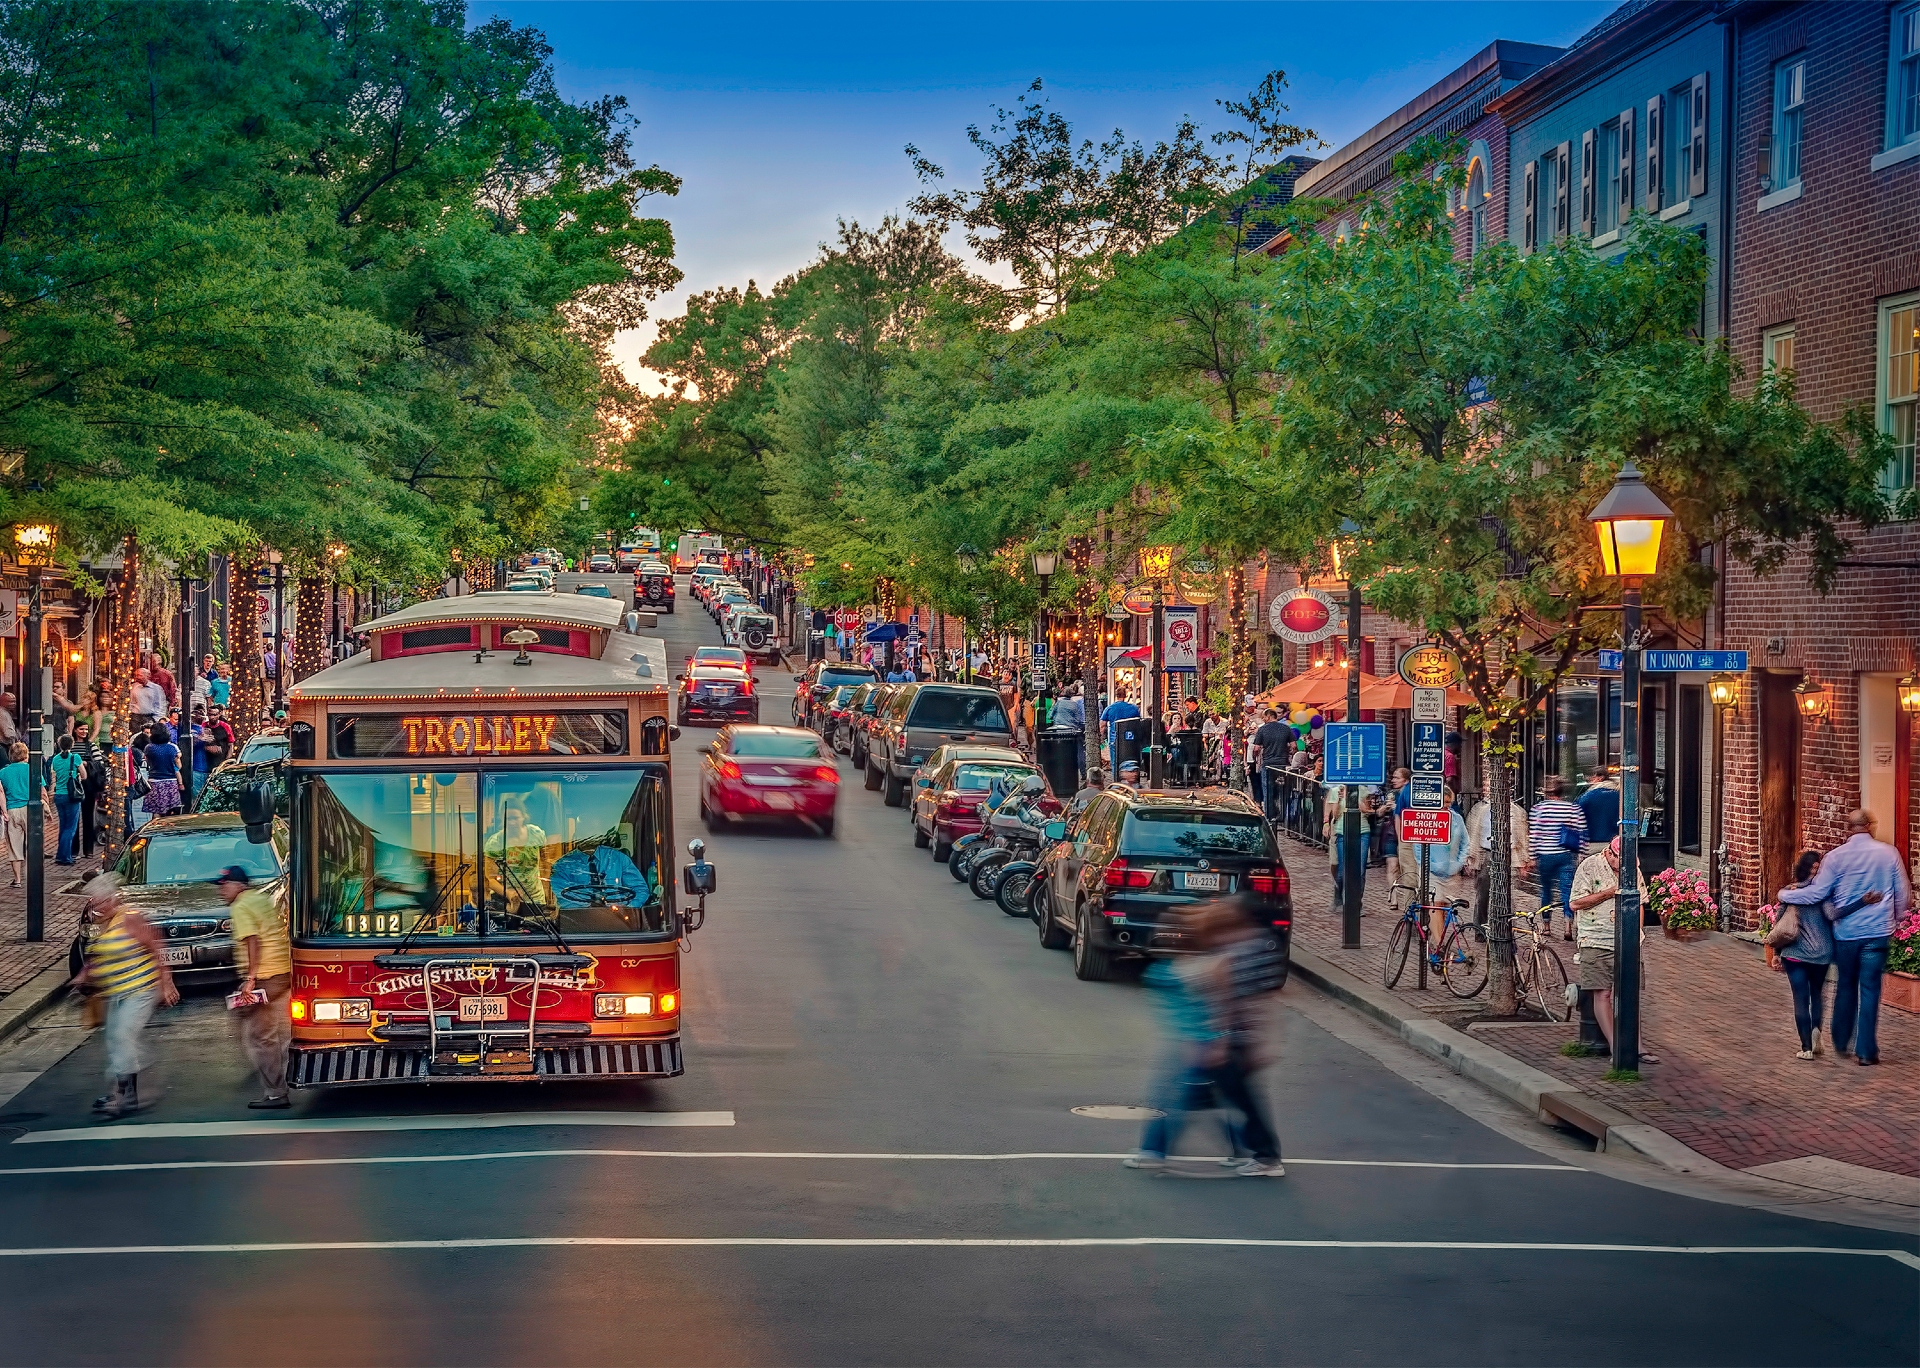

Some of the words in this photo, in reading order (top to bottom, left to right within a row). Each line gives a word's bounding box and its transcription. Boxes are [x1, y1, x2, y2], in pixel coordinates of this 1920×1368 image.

[1274, 591, 1290, 611] OLD
[837, 613, 859, 623] STOP
[1283, 610, 1328, 619] POP'S
[1174, 626, 1189, 635] 1812
[1280, 626, 1305, 641] CREAM
[1307, 617, 1338, 641] COMPANY
[1413, 652, 1449, 666] FISH
[1650, 653, 1657, 668] N
[1661, 653, 1693, 669] UNION
[1727, 652, 1738, 661] ST
[1724, 660, 1738, 669] 100
[1408, 669, 1456, 685] MARKET
[401, 715, 556, 753] TROLLEY
[1422, 725, 1434, 740] P
[1415, 812, 1438, 820] SNOW
[1403, 819, 1449, 829] EMERGENCY
[1413, 828, 1438, 836] ROUTE
[345, 914, 401, 933] 1302
[171, 951, 189, 961] 5424
[376, 974, 424, 996] KING
[463, 1003, 505, 1016] 167-698L
